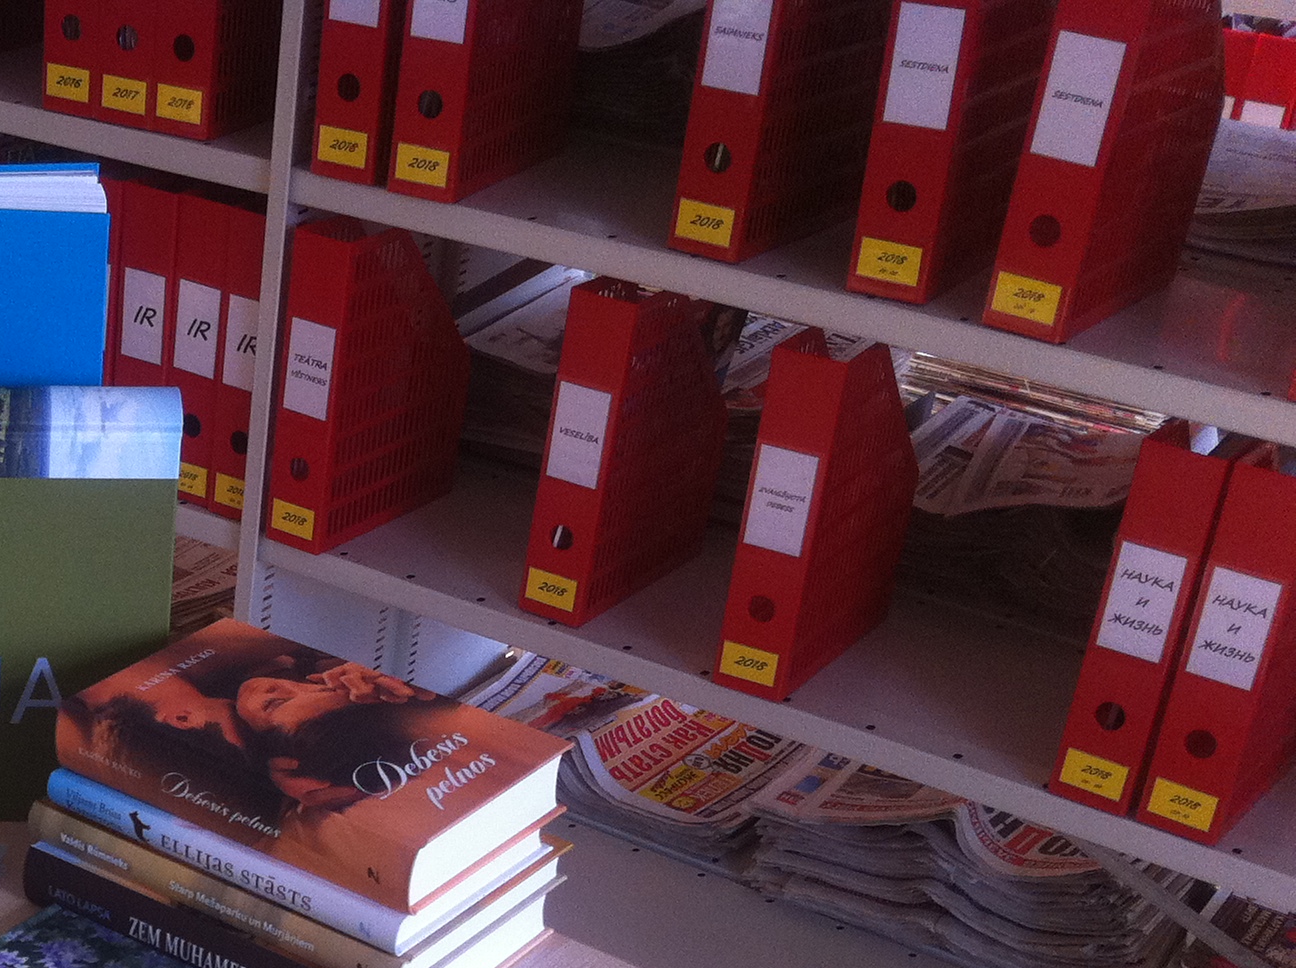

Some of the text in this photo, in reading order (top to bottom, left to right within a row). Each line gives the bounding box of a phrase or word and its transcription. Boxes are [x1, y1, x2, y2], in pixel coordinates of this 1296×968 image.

[899, 59, 949, 74] SESTDIENA
[56, 75, 83, 88] 2016
[112, 87, 140, 100] 2017
[167, 96, 194, 110] 2018
[1052, 89, 1103, 108] SESTDIENA
[330, 139, 358, 153] 2018
[408, 157, 440, 172] 2018
[690, 214, 725, 230] 2018
[877, 251, 908, 265] 2018
[1012, 286, 1045, 302] 2018
[134, 305, 157, 327] IR
[187, 318, 211, 341] IR
[559, 425, 599, 445] VESELĪBA
[281, 511, 307, 526] 2018
[538, 581, 567, 597] 2018
[1121, 568, 1175, 592] НАУКА
[1135, 597, 1150, 608] И
[1212, 594, 1268, 619] НАУКА
[1108, 612, 1163, 636] ЖИЗНЬ
[1227, 623, 1242, 635] И
[1198, 640, 1255, 664] ЖИЗНЬ
[734, 655, 768, 671] 2018
[594, 700, 688, 763] богатым
[662, 719, 716, 751] Как
[352, 732, 468, 800] Debesis
[609, 743, 674, 783] стать
[1081, 764, 1112, 780] 2018
[426, 753, 496, 811] pelnos
[161, 771, 280, 838] Debesis pelnos
[1170, 794, 1202, 810] 2018
[60, 832, 85, 852] Valdis
[168, 880, 194, 900] Starp
[195, 889, 248, 924] Mežaparku
[248, 915, 261, 927] un
[128, 917, 162, 948] ZEM
